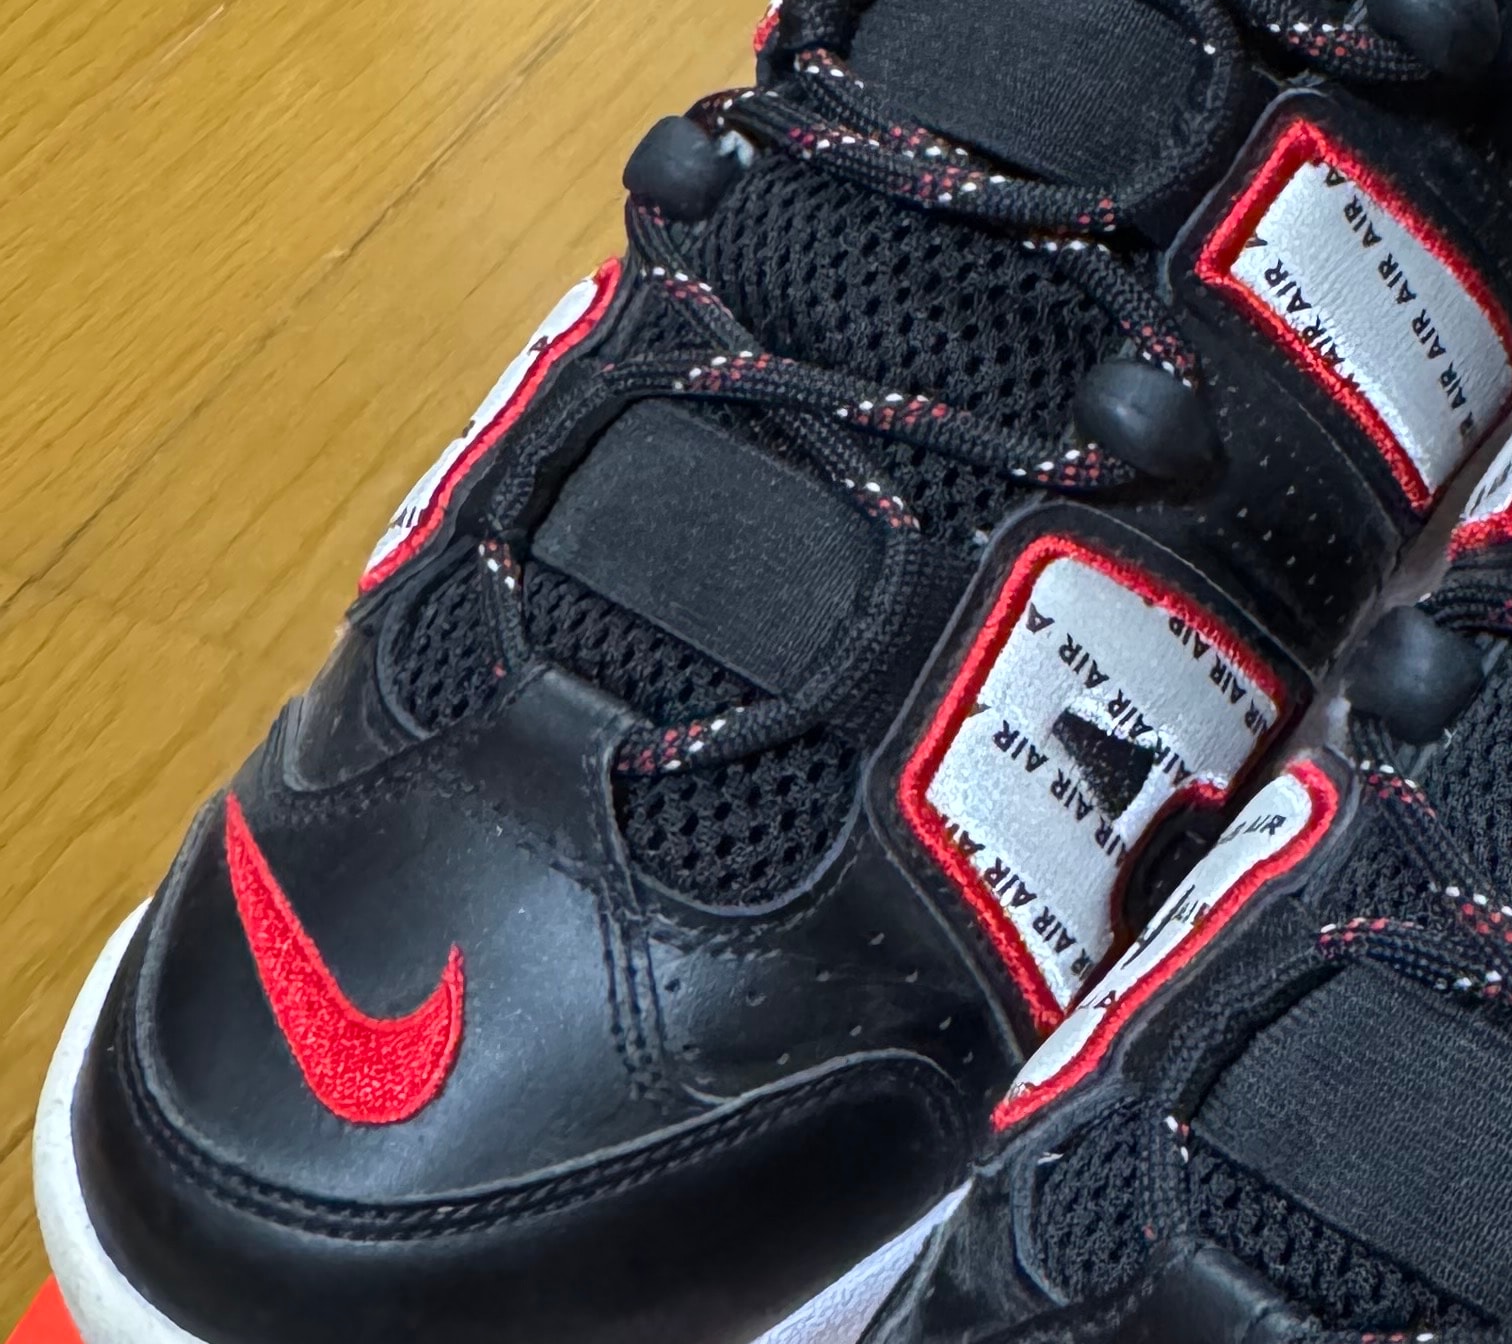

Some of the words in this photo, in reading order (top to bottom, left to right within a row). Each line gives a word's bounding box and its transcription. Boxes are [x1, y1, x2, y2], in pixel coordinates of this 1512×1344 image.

[1343, 194, 1383, 249] AIR
[1263, 258, 1313, 315] AIR
[1377, 252, 1417, 305] AIR
[1411, 308, 1447, 360] AIR
[1438, 361, 1467, 411] AIR
[1057, 632, 1111, 690] AIR
[1208, 653, 1248, 705] AIR
[1105, 688, 1154, 737] AIR
[991, 719, 1050, 774] AIR
[1049, 767, 1097, 822] AIR
[984, 856, 1038, 909] AIR
[1031, 905, 1078, 955] AIR
